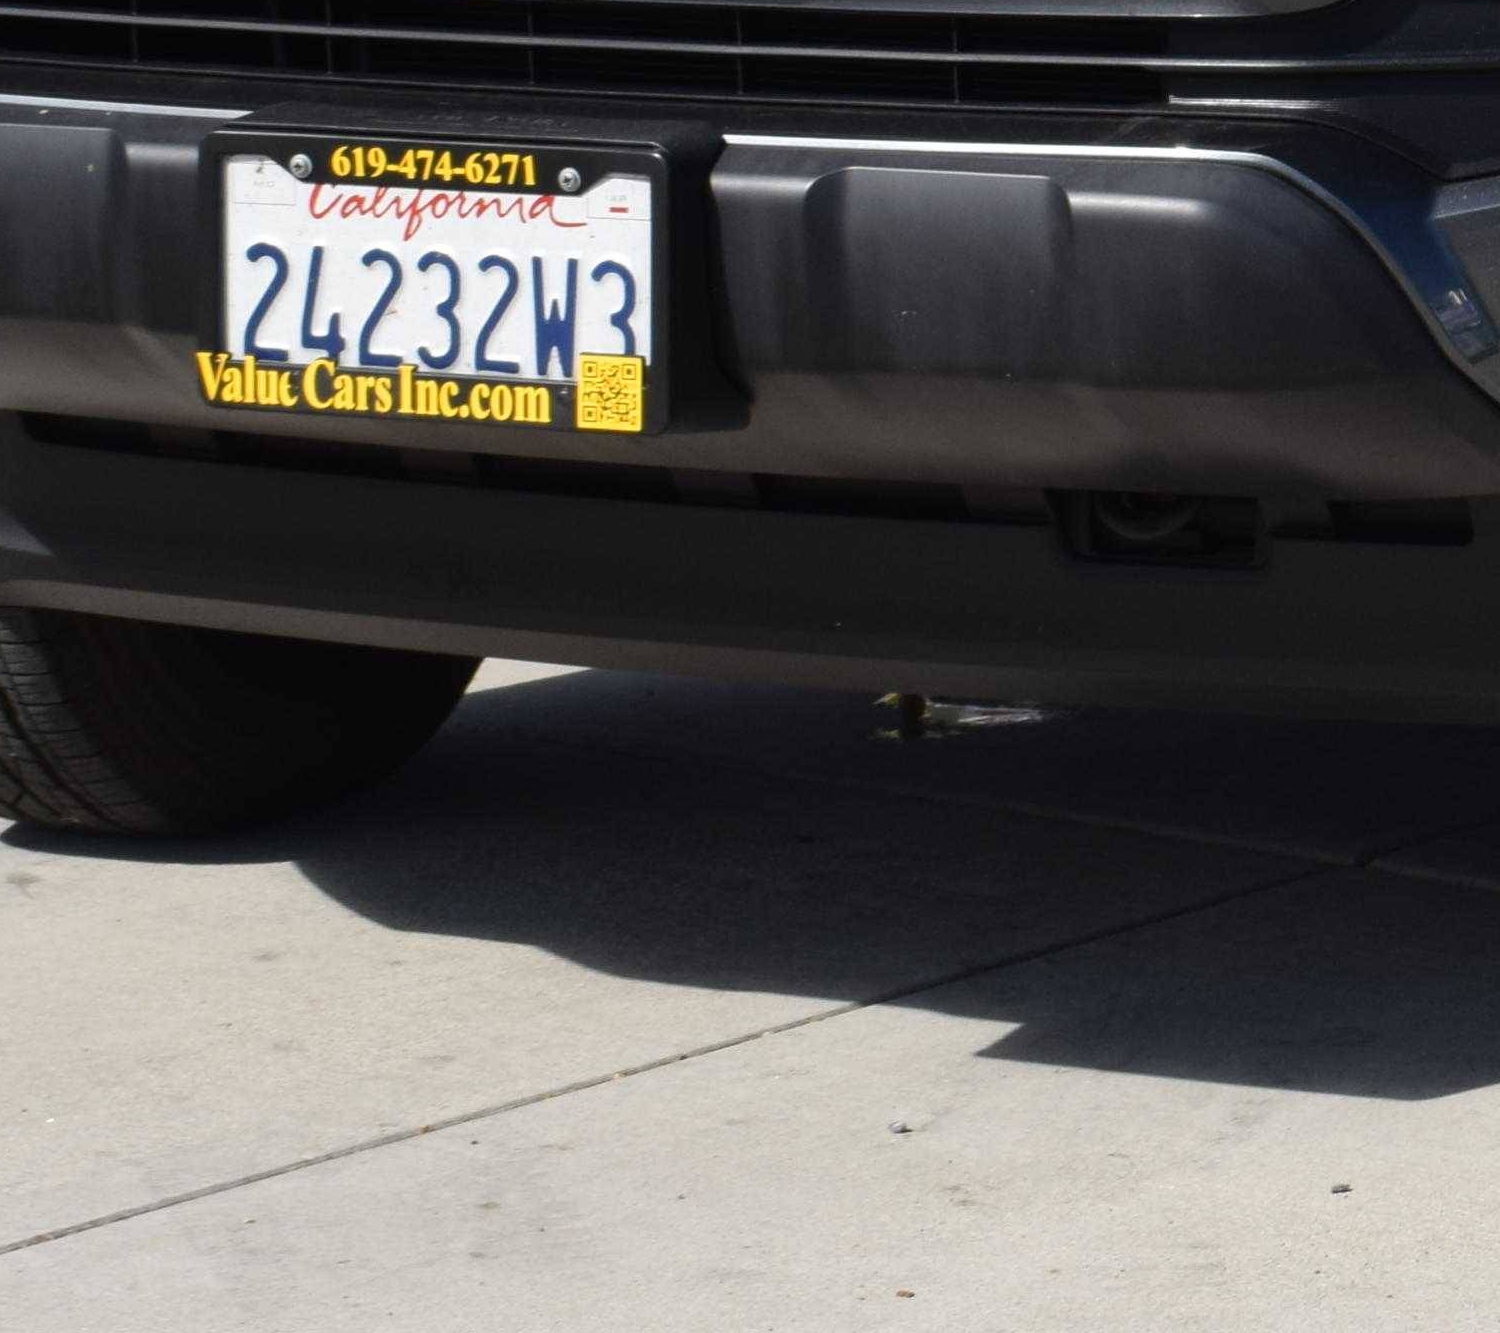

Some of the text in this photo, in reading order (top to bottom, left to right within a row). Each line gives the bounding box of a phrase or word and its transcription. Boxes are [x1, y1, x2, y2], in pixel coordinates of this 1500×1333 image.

[330, 145, 537, 187] 619-474-6271
[307, 183, 588, 242] California
[243, 241, 637, 379] 24232W3
[301, 356, 393, 414] Cars
[398, 363, 552, 424] Inc.com
